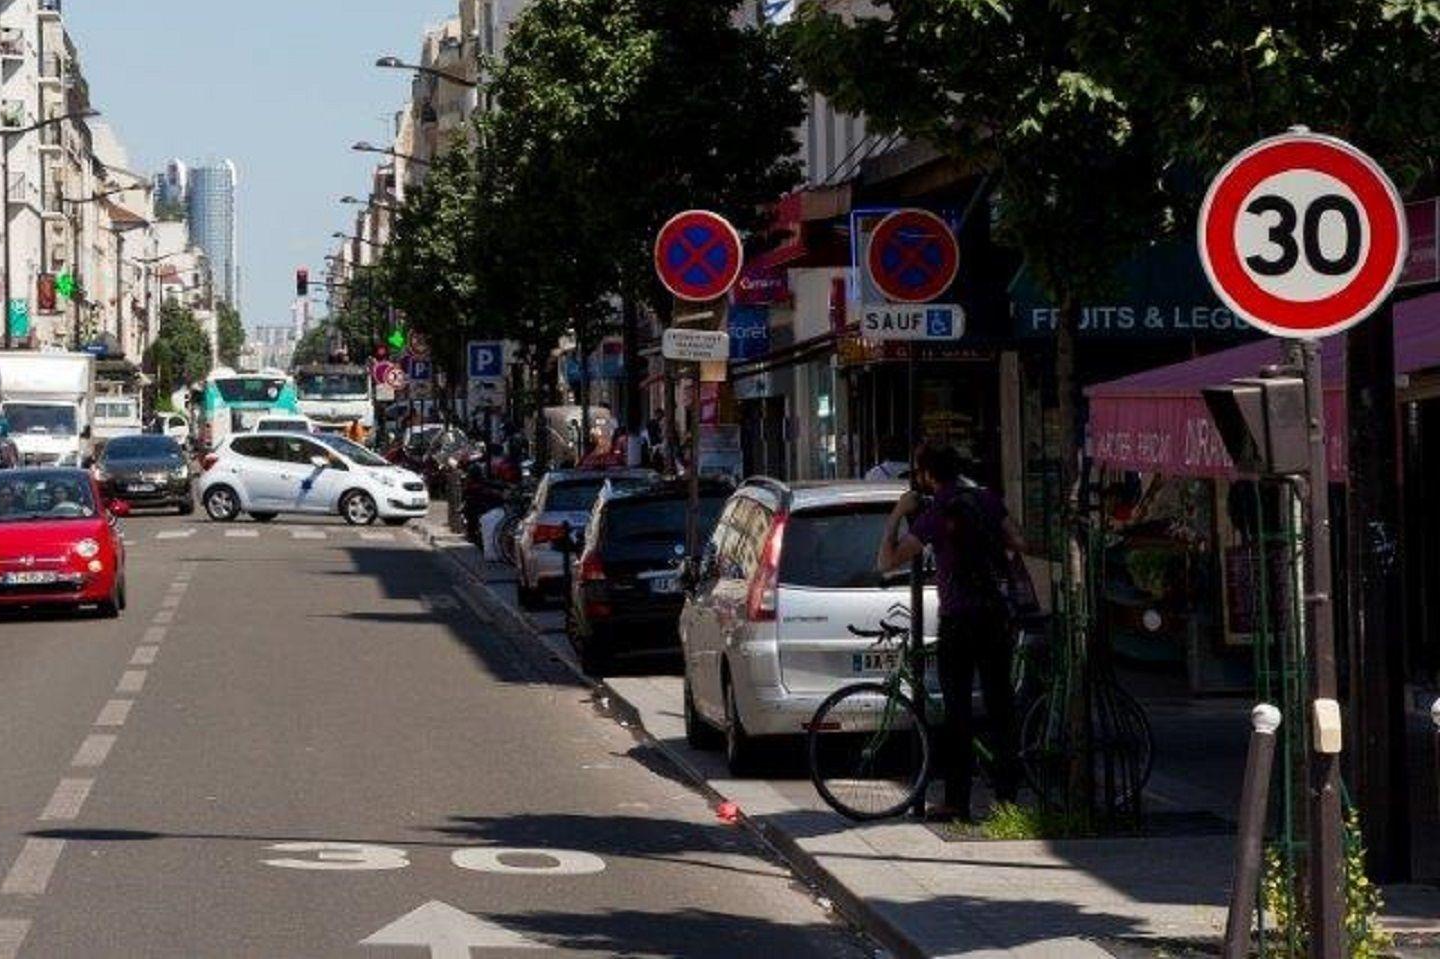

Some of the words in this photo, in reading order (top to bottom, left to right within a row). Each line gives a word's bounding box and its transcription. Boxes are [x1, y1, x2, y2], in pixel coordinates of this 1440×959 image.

[1244, 195, 1361, 276] 30
[866, 312, 923, 330] SAUF
[1144, 306, 1163, 329] &
[477, 348, 495, 372] P
[260, 841, 607, 874] 30
